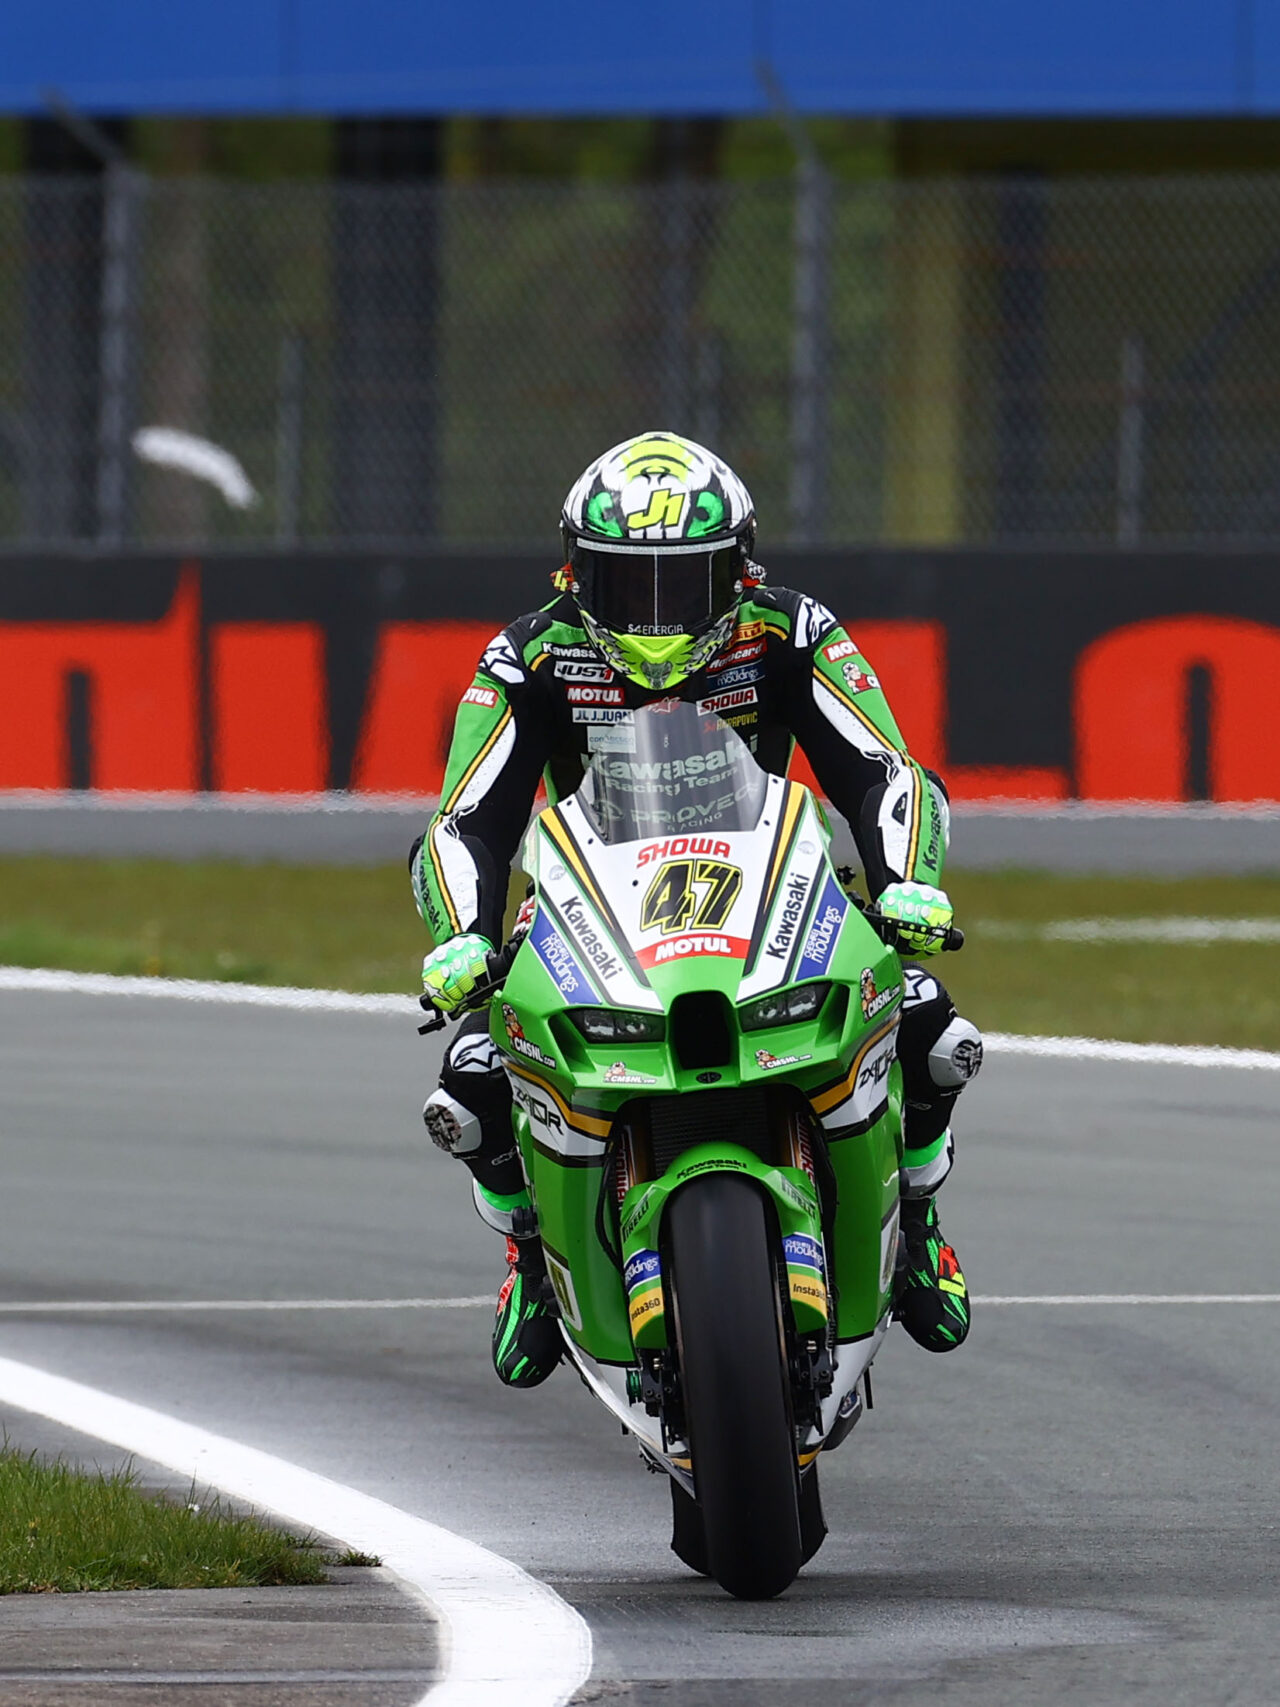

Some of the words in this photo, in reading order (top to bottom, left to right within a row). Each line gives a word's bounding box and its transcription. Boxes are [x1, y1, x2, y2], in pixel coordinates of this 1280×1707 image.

[543, 642, 598, 659] Kawasa
[557, 664, 611, 681] JUST1
[462, 688, 495, 706] OTUL
[567, 687, 622, 703] MOTUL
[701, 689, 755, 712] SHOWA
[580, 734, 759, 780] Kawasaki
[606, 778, 680, 796] Racing
[684, 767, 738, 789] Team
[636, 839, 731, 868] SHOWA
[639, 859, 743, 934] 47
[766, 872, 810, 960] Kawasaki
[560, 896, 624, 980] Kawasaki
[811, 905, 842, 964] mouldings
[539, 936, 579, 993] mouldings
[655, 938, 732, 962] MOTUL
[677, 1158, 748, 1180] Kawasaki
[622, 1195, 653, 1244] PIRELLI
